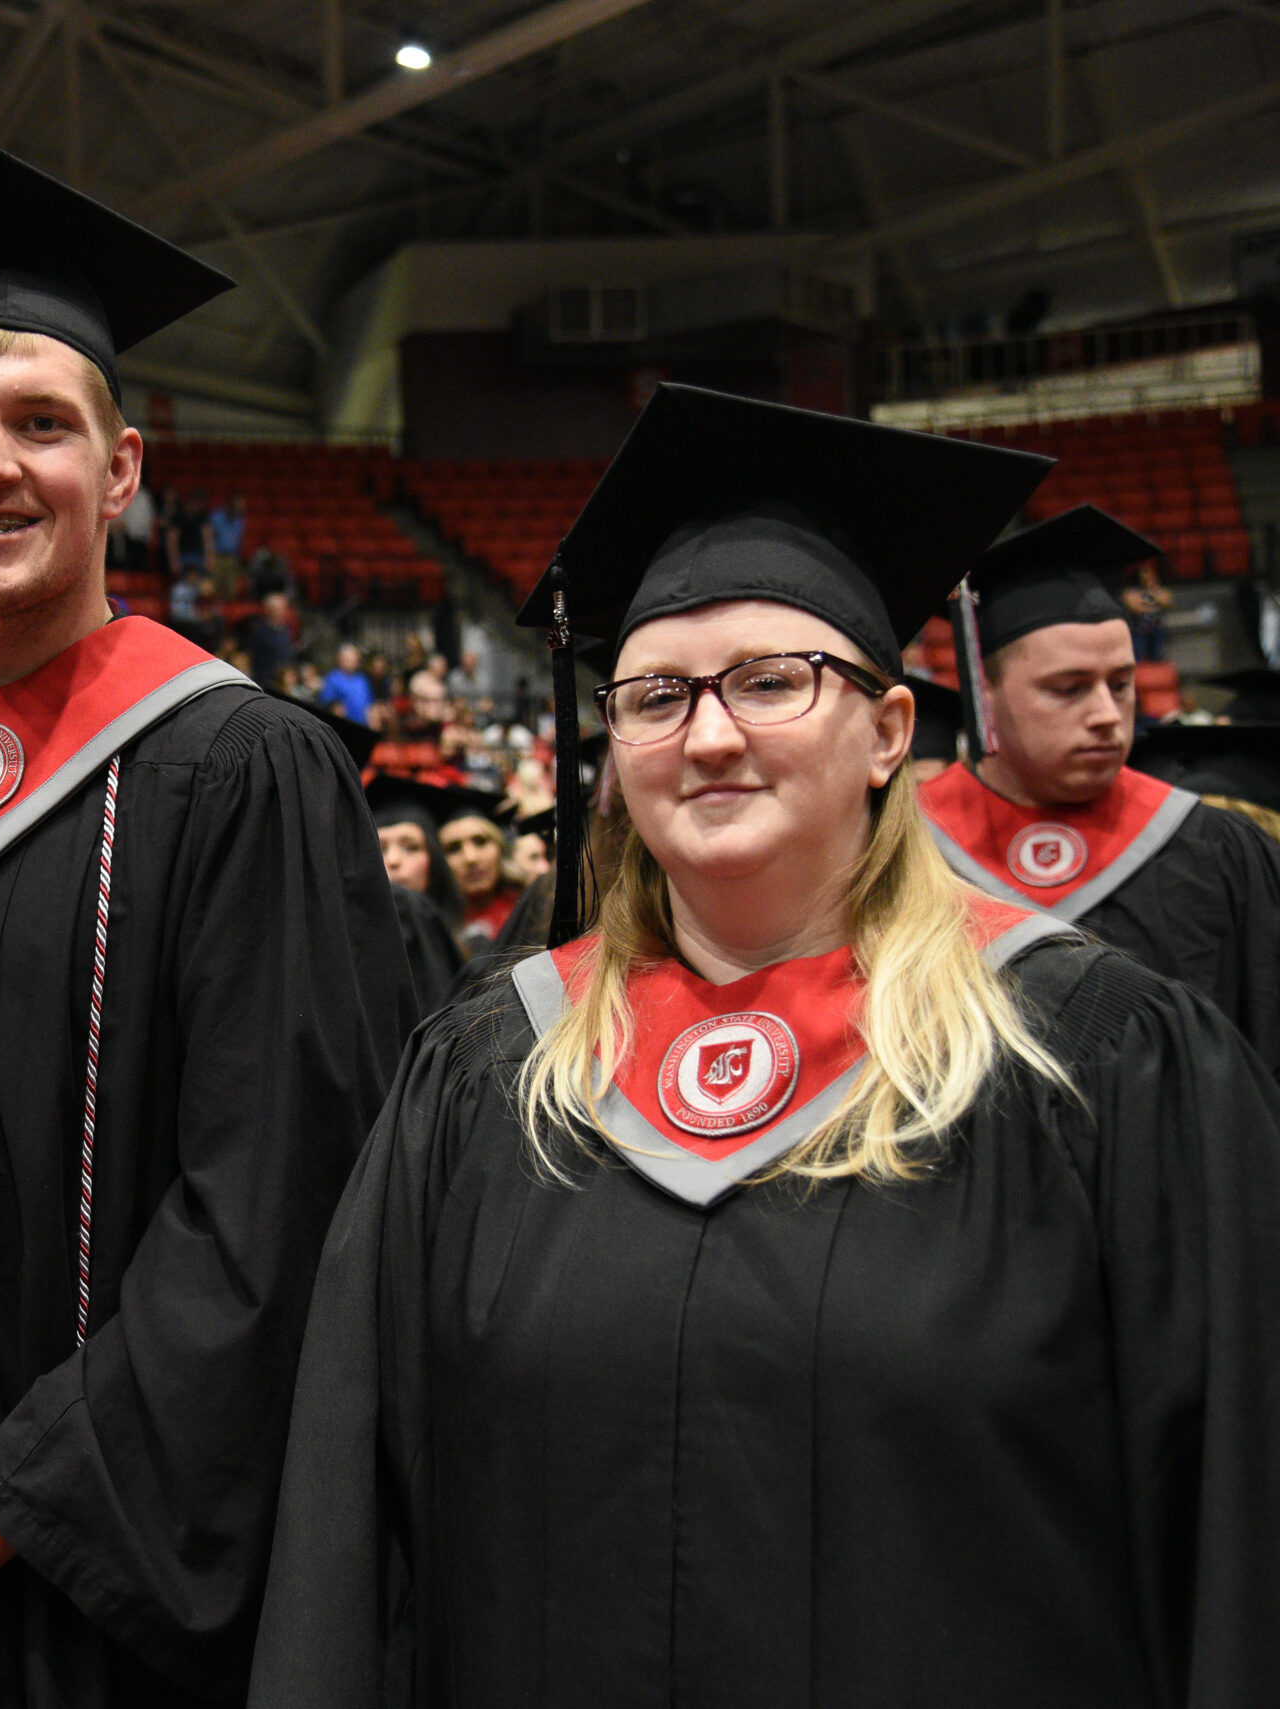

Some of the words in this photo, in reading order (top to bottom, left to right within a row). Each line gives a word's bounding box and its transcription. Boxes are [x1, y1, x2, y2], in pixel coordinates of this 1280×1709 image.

[664, 1020, 719, 1089] WASHINGTON
[721, 1014, 757, 1026] STATE
[757, 1018, 790, 1078] UNIVERSITY
[675, 1106, 736, 1128] FOUNDED
[740, 1101, 769, 1124] 1890
